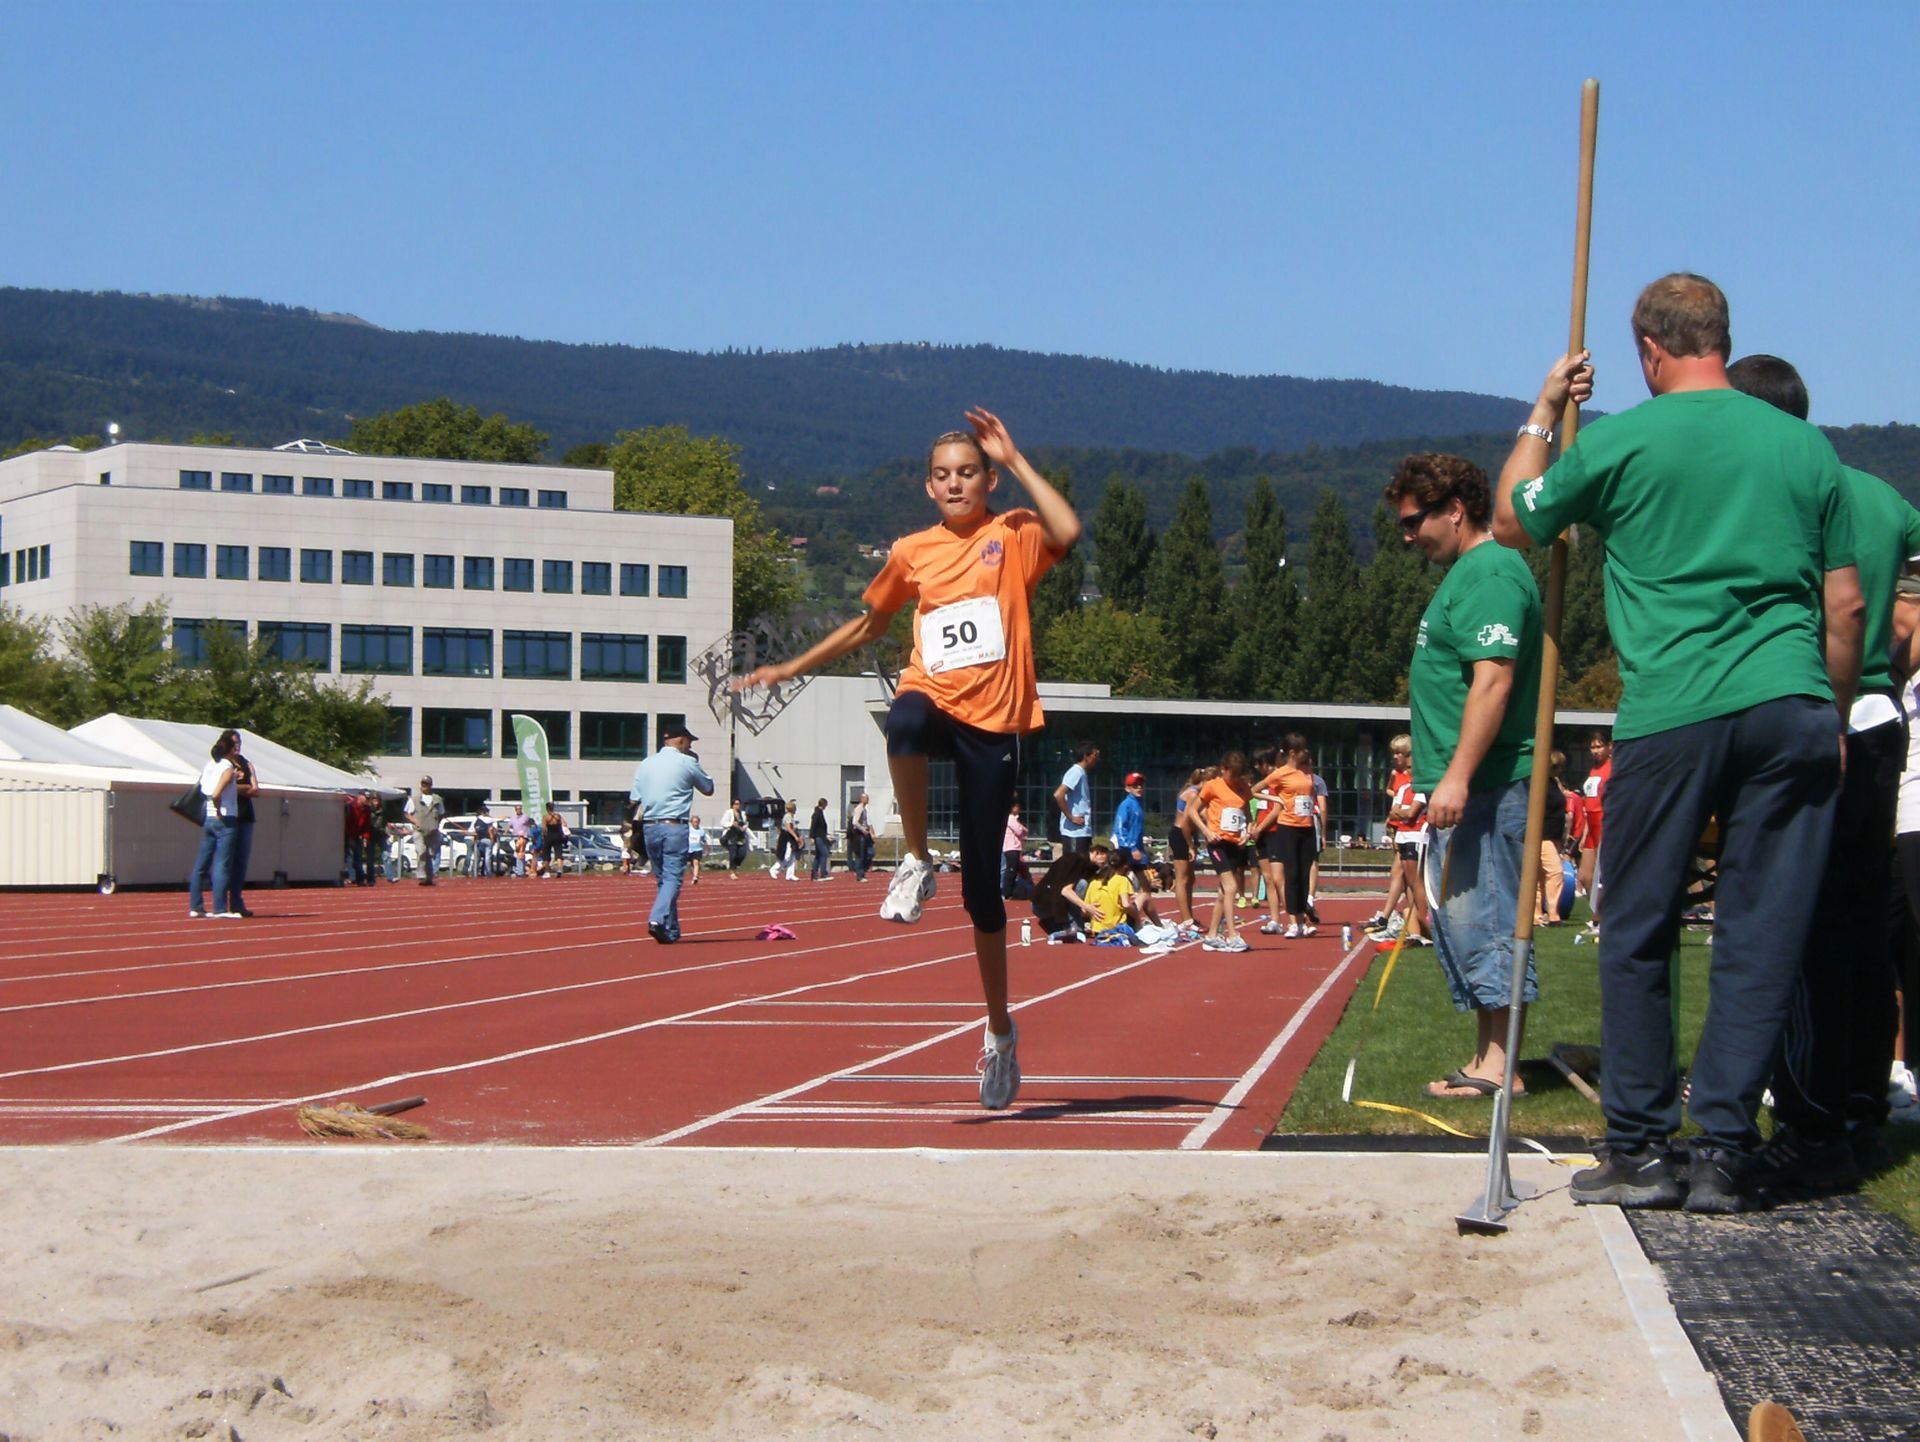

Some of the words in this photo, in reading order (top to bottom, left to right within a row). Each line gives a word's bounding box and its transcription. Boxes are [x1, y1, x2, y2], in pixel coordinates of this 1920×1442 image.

[942, 620, 978, 649] 50
[1302, 801, 1312, 810] 52
[1231, 814, 1242, 825] 51
